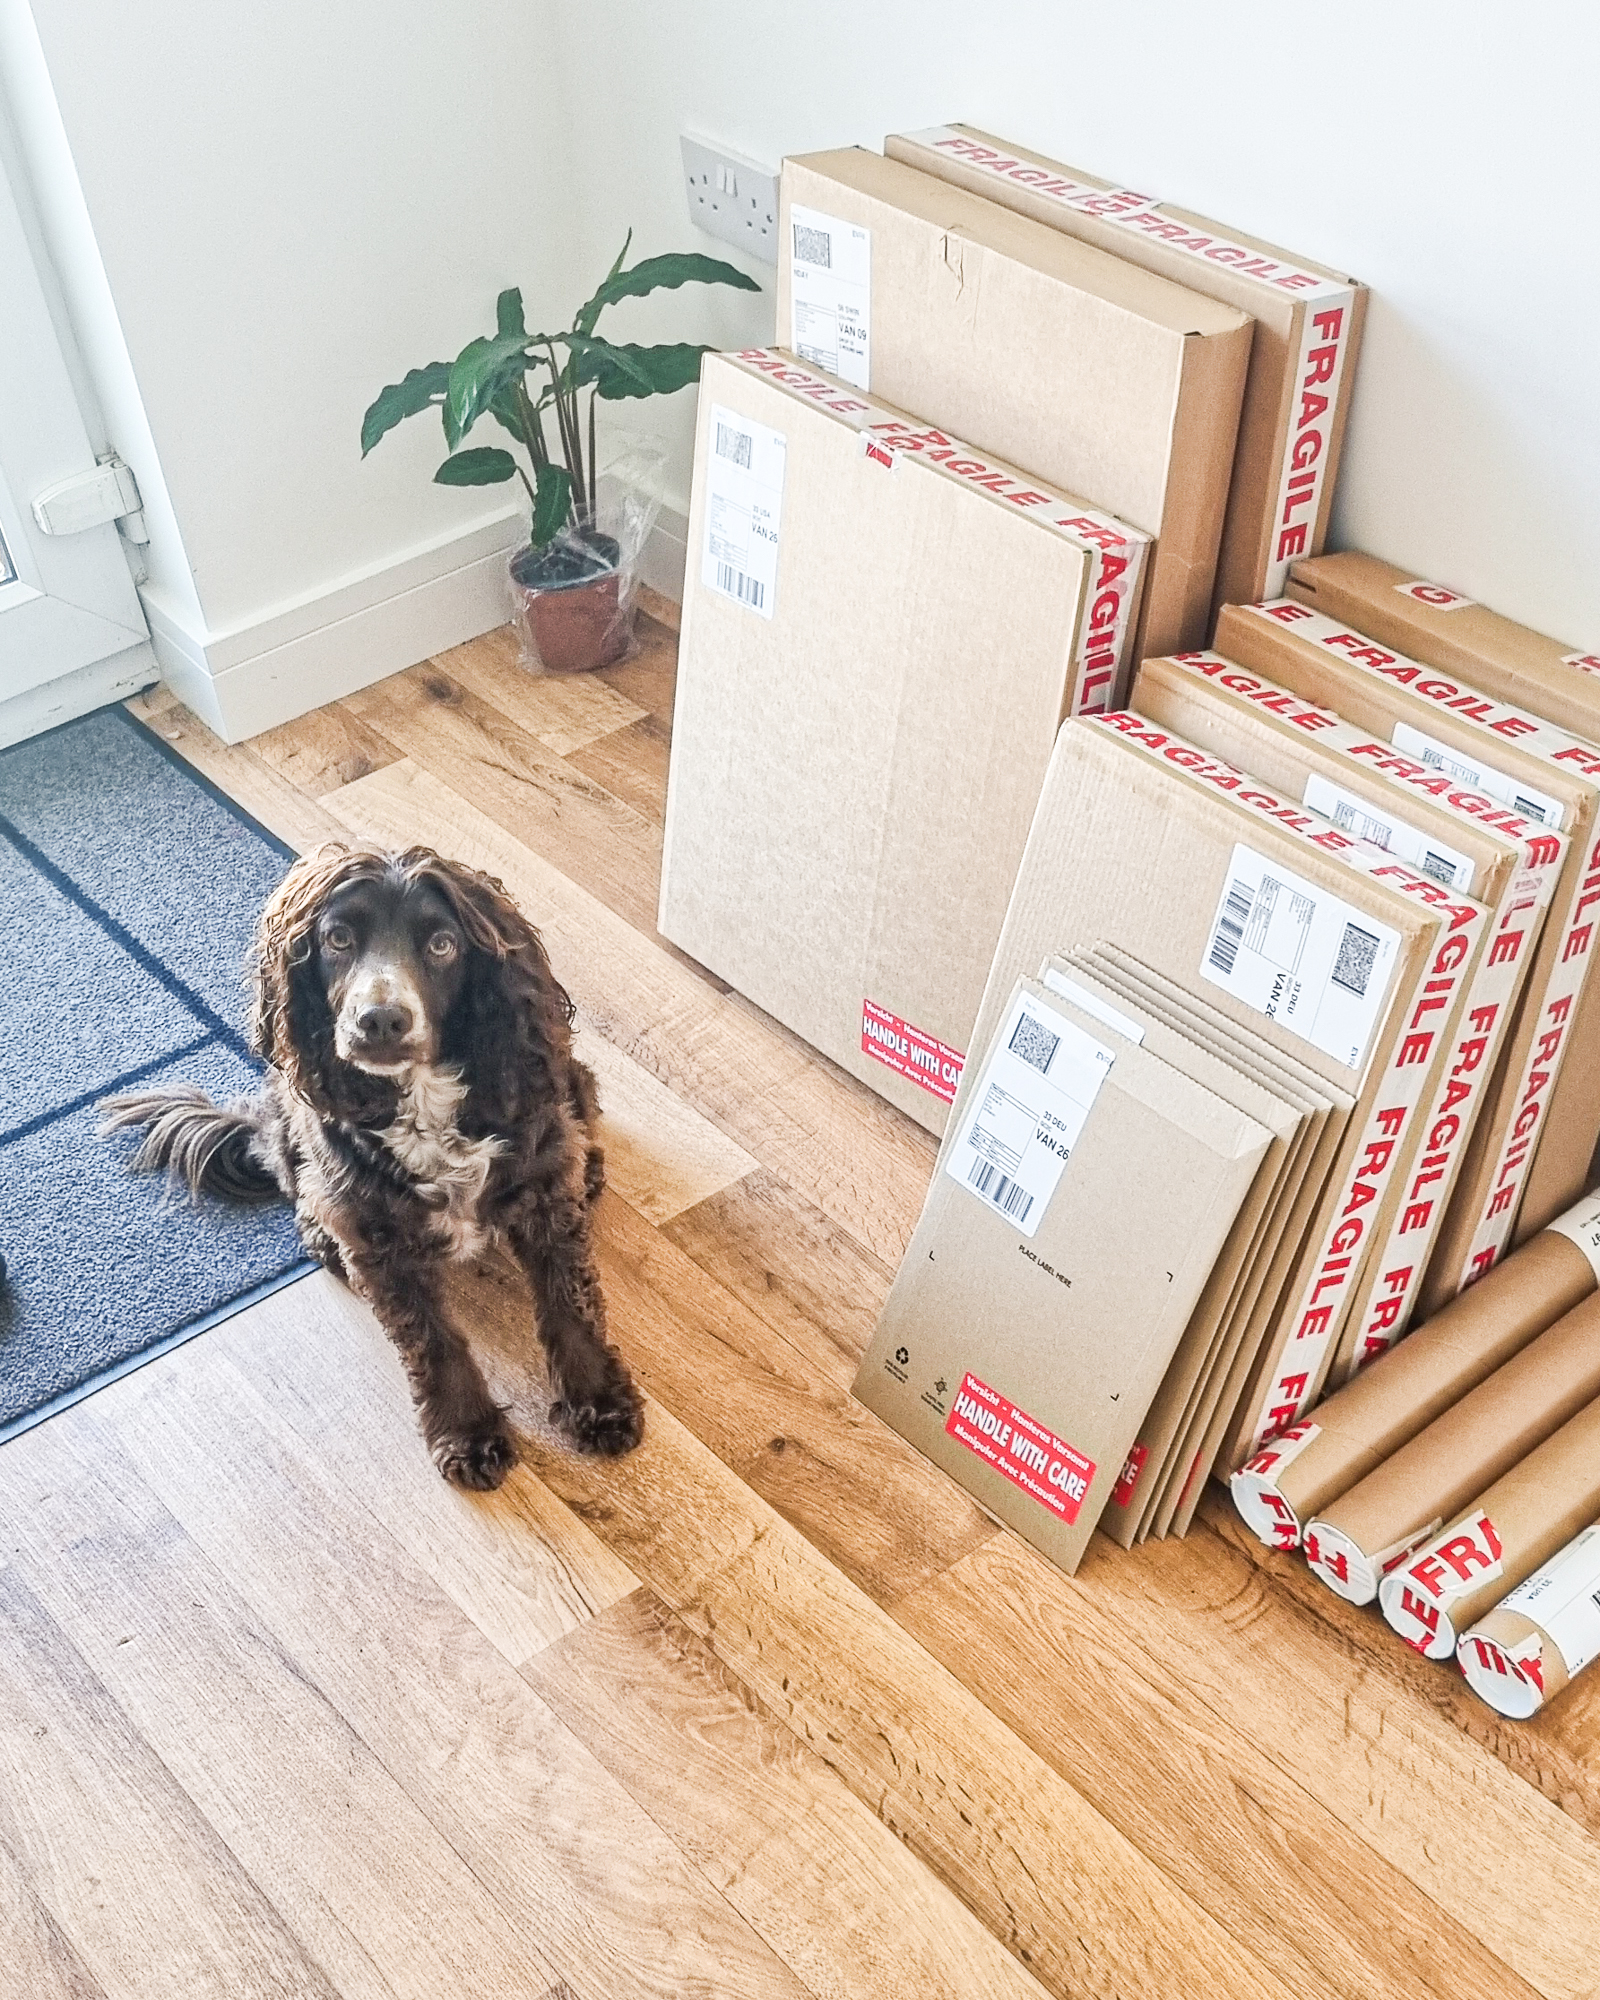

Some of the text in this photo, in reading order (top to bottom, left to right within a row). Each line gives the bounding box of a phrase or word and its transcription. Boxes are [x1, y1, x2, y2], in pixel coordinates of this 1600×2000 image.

[1118, 212, 1321, 290] FRAGILE
[839, 323, 856, 337] VAN
[1276, 308, 1344, 562] FRAGILE
[752, 521, 779, 544] VAN 26
[1323, 634, 1539, 738] FRAGILE
[1347, 743, 1561, 869] FRAGILE
[1270, 973, 1286, 1002] VAN
[1287, 993, 1299, 1015] DEU
[1369, 866, 1478, 1068] FRAGILE
[862, 1016, 908, 1057] HANDLE
[910, 1043, 940, 1076] WITH
[1036, 1128, 1070, 1161] VAN 26
[1052, 1116, 1068, 1132] DEU
[1399, 1003, 1500, 1235] FRAGILE
[1486, 994, 1573, 1221] FRAGILE
[1297, 1107, 1407, 1340] FRAGILE
[1019, 1244, 1072, 1289] PLACE LABEL HERE
[966, 1375, 1000, 1406] Vorsicht
[953, 1391, 1012, 1447] HANDLE
[1009, 1431, 1050, 1475] WITH
[1047, 1461, 1087, 1503] CARE
[954, 1423, 1066, 1512] Manipuler Avec Précaution
